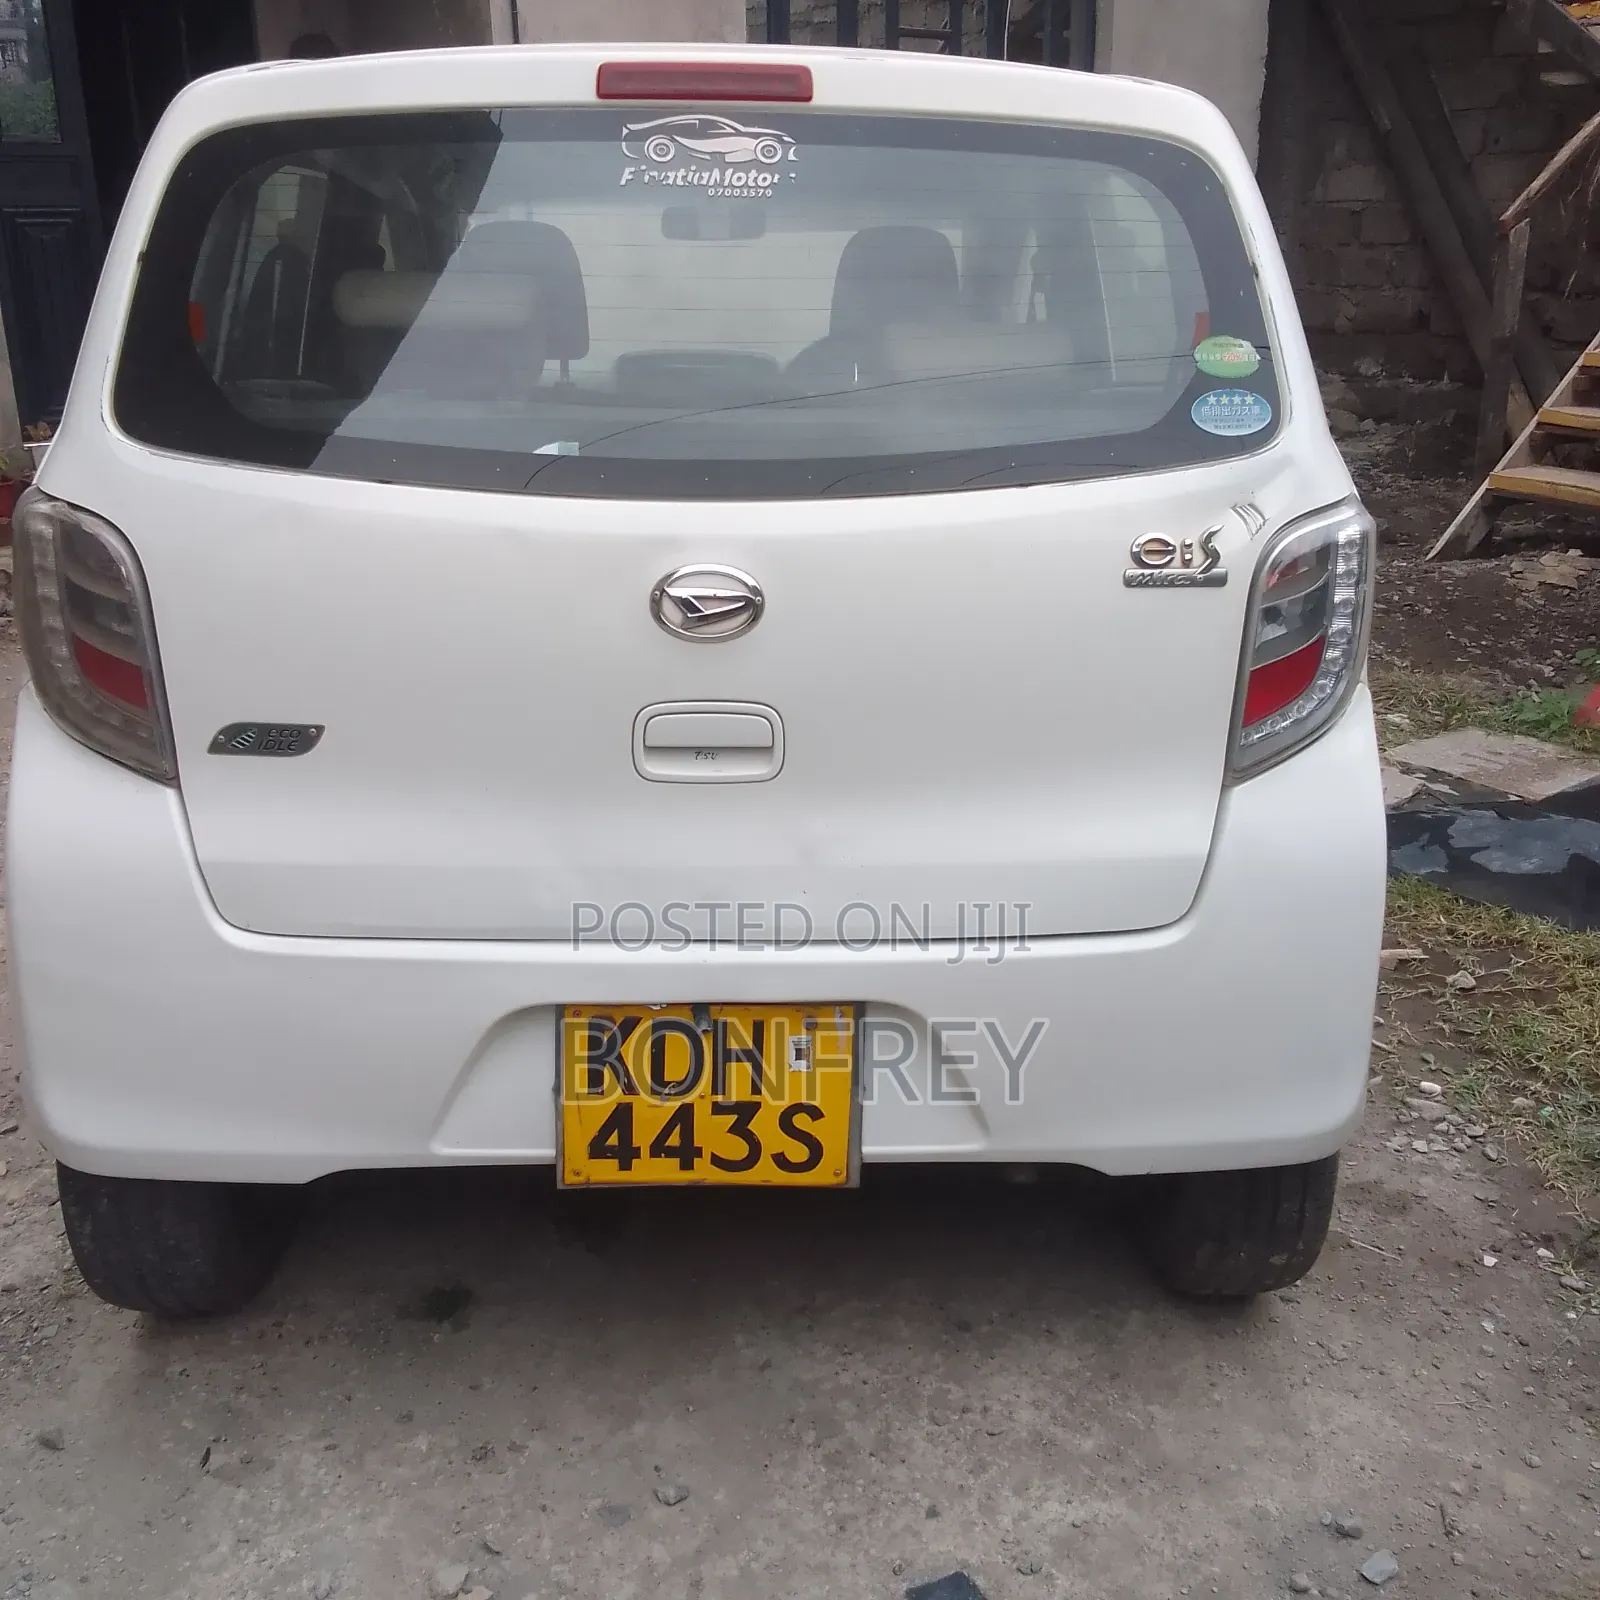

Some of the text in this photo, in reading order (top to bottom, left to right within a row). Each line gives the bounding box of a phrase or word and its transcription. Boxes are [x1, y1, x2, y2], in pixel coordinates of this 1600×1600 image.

[1131, 570, 1191, 586] Mira
[268, 728, 301, 739] eco
[257, 739, 299, 752] IDLE
[587, 1101, 827, 1175] 443S
